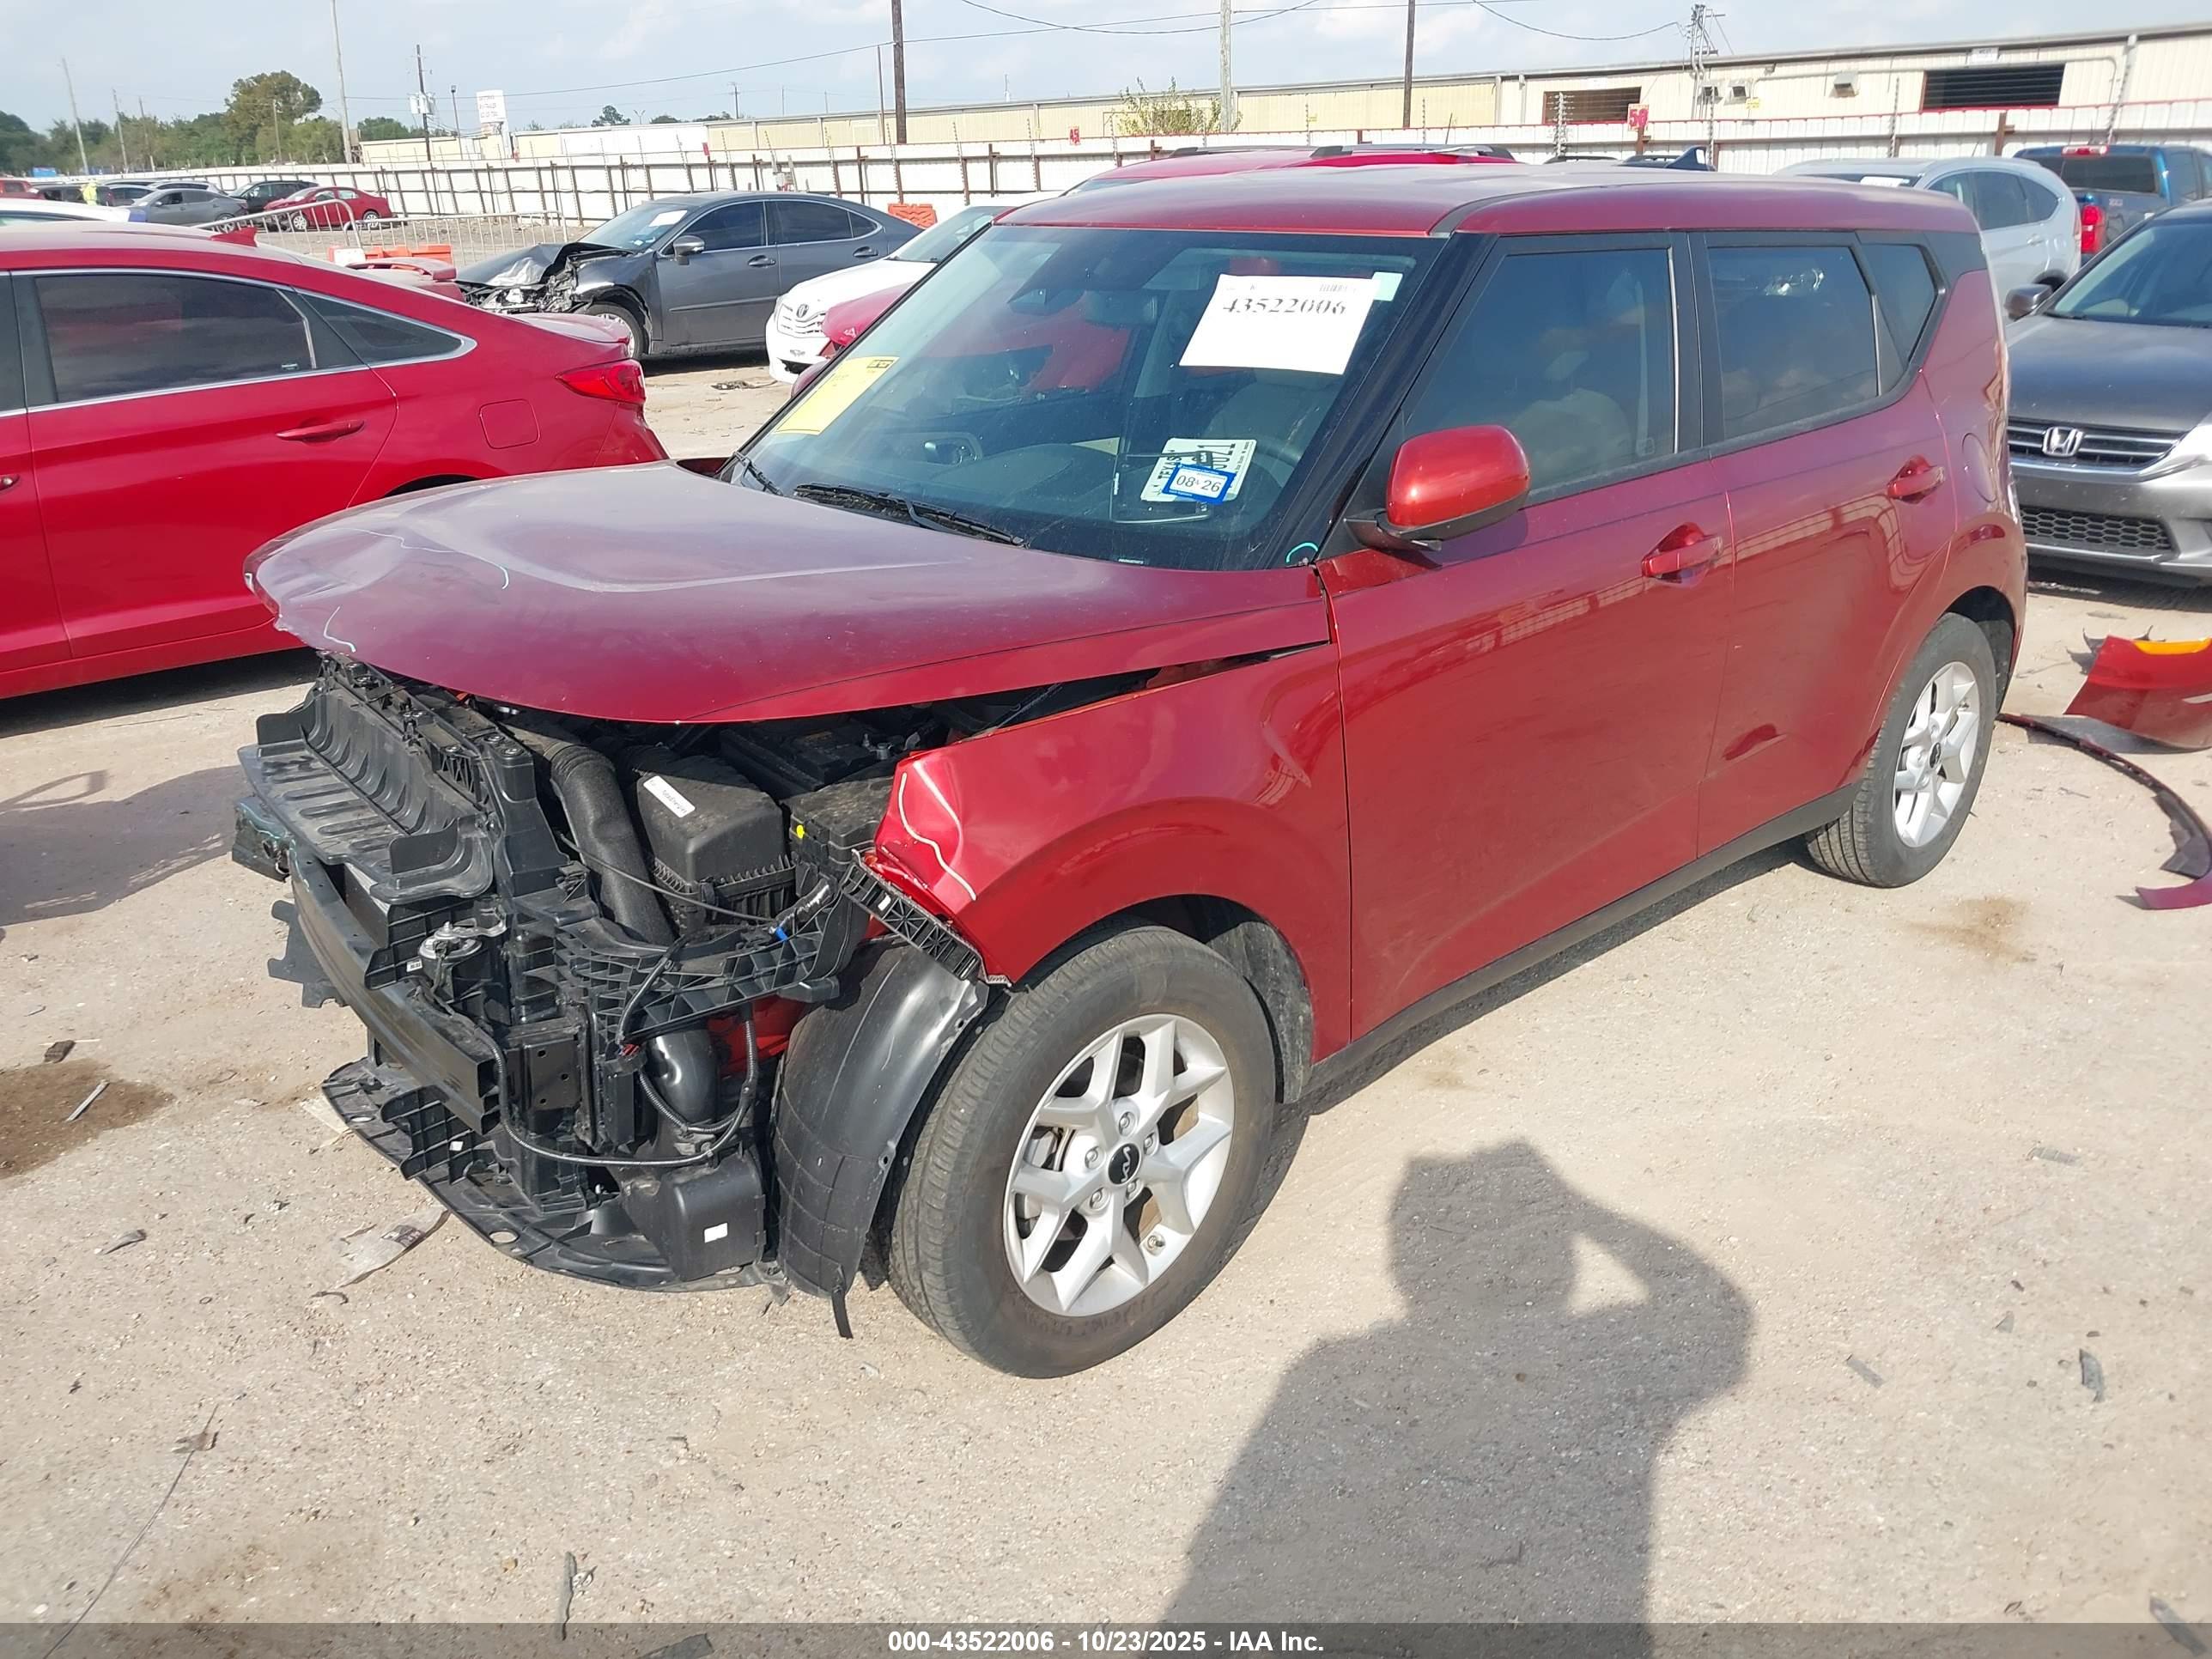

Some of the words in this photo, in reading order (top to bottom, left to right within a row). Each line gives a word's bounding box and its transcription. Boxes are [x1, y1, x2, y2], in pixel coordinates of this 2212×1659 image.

[1223, 297, 1346, 314] 43522006
[1176, 474, 1196, 489] 08
[1200, 478, 1223, 494] 26
